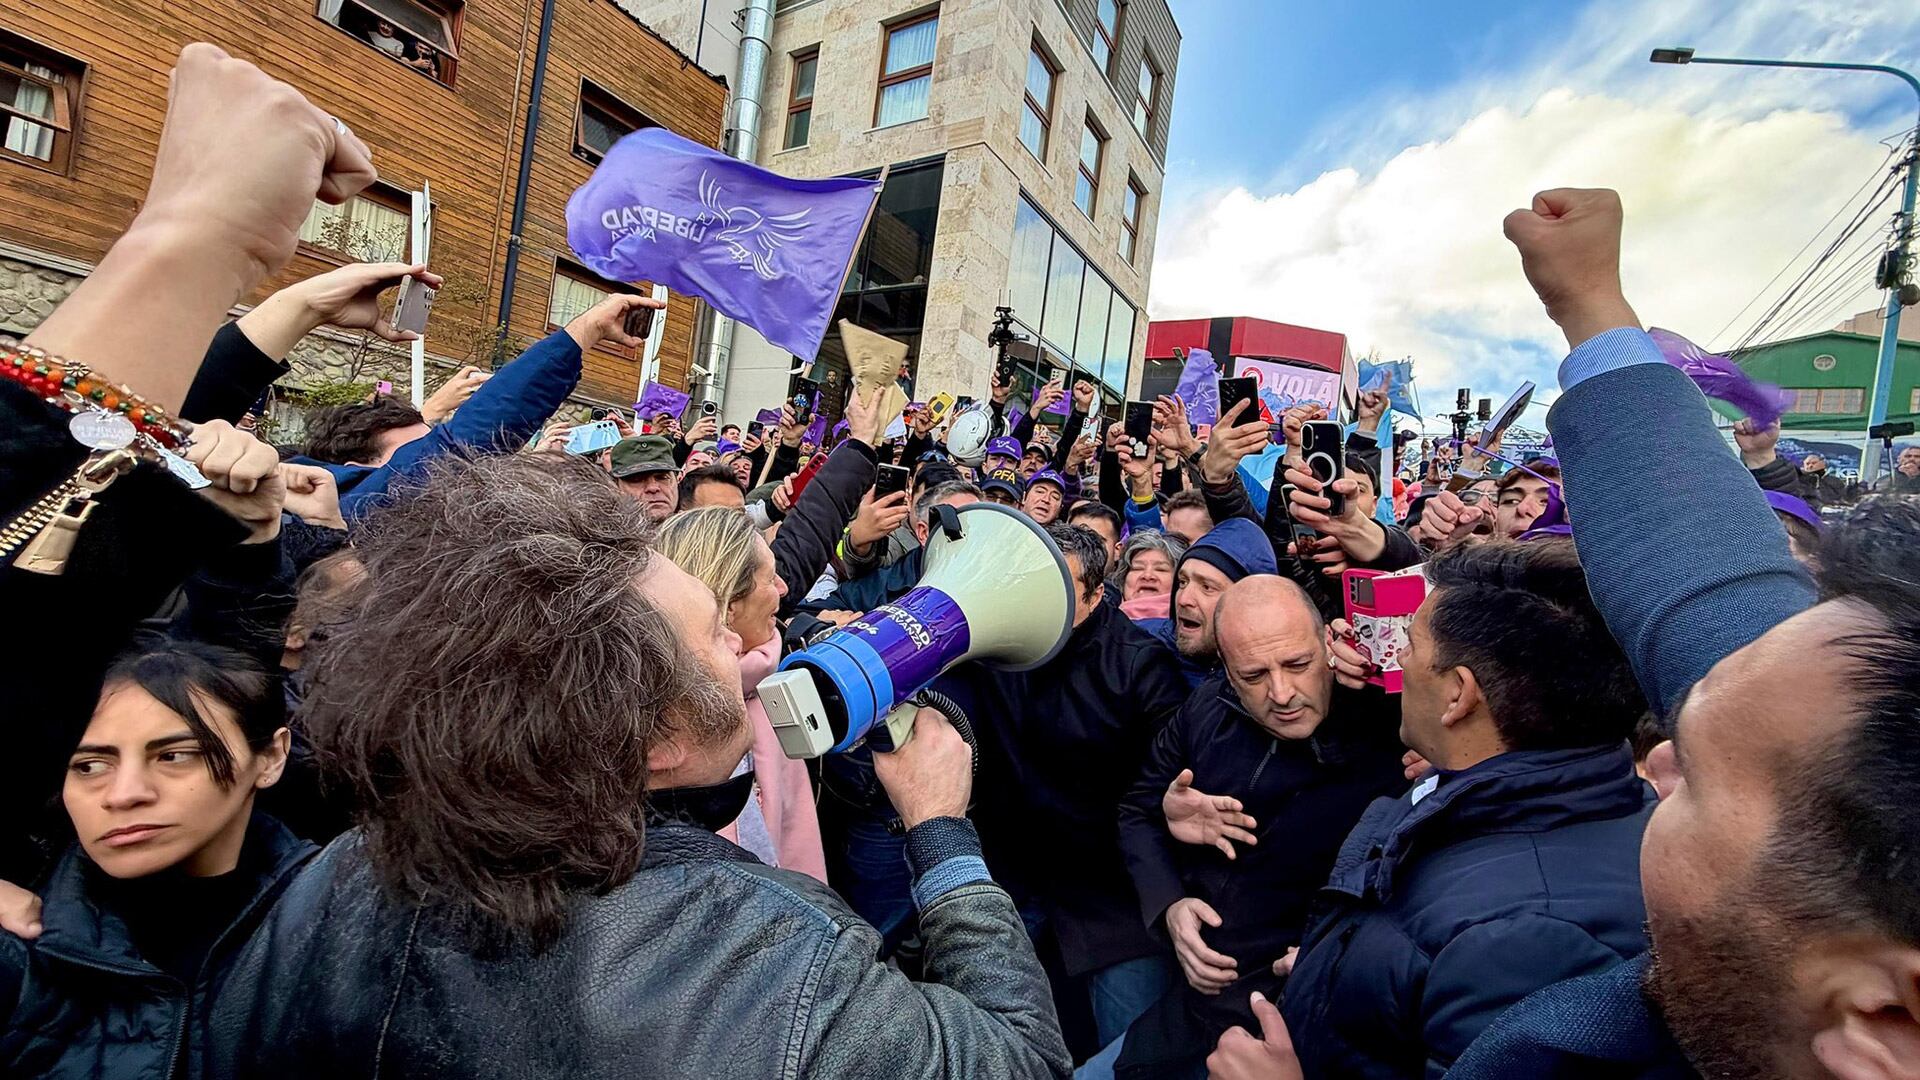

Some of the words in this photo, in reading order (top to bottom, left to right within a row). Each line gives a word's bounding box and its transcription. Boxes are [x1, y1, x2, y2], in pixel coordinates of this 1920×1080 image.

[1271, 371, 1334, 402] VOLÁ
[992, 469, 1015, 485] PFA
[886, 613, 923, 650] AVANZA
